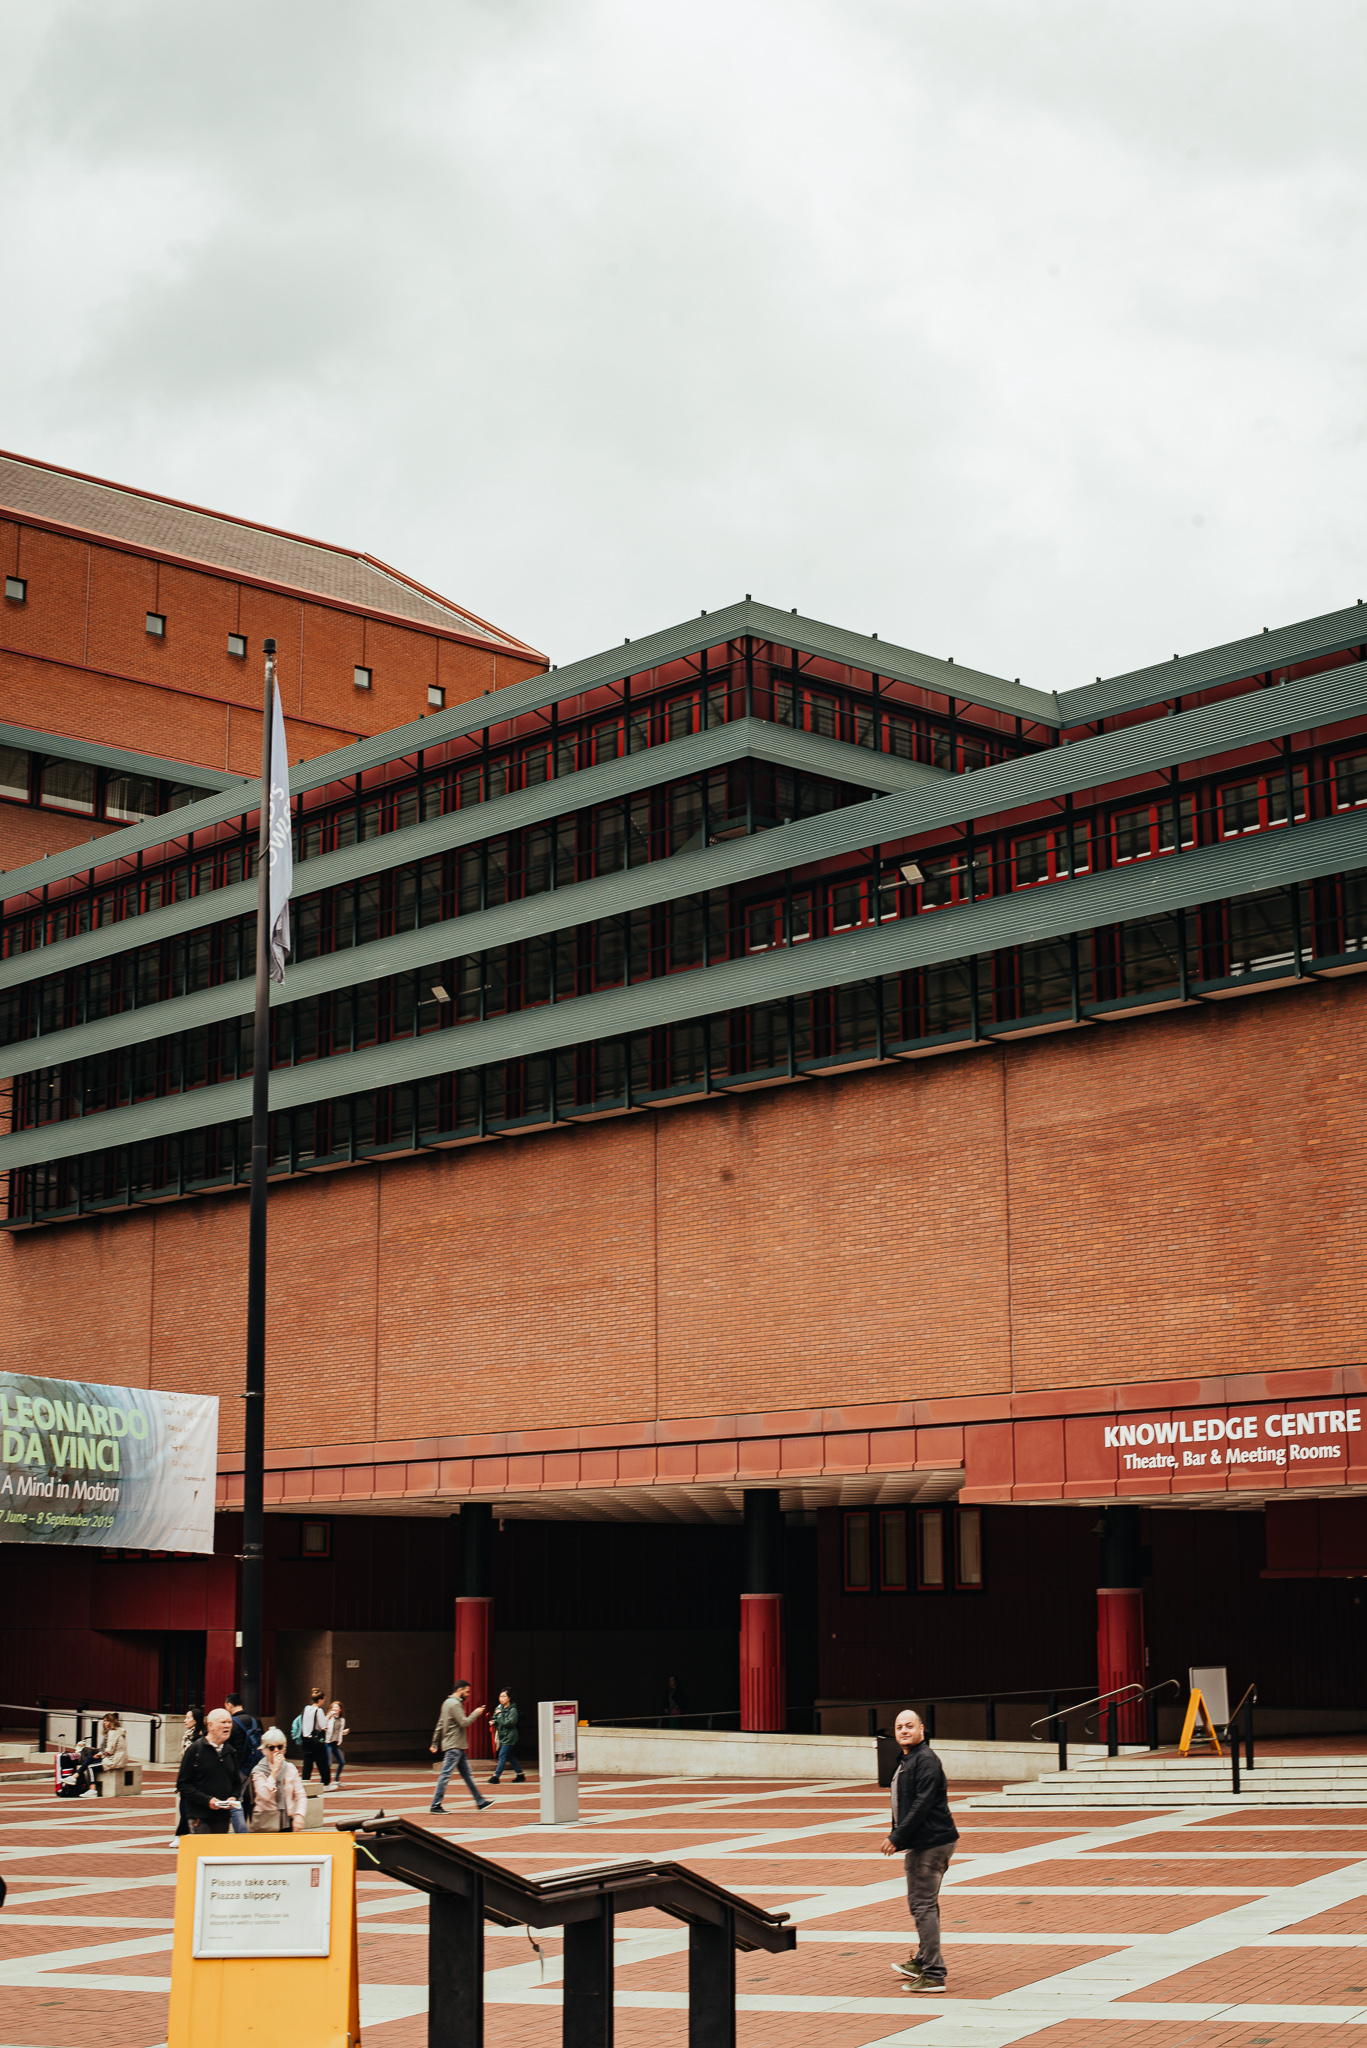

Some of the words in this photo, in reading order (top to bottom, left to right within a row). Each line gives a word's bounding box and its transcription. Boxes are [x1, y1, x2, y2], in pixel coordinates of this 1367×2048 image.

[0, 1393, 149, 1440] LEONARDO
[1104, 1416, 1258, 1448] KNOWLEDGE
[1264, 1409, 1362, 1438] CENTRE
[2, 1430, 46, 1466] DA
[49, 1434, 120, 1472] VINCI
[1123, 1453, 1179, 1470] Theatre,
[1183, 1450, 1207, 1467] Bar
[1210, 1448, 1222, 1465] &
[1226, 1446, 1286, 1466] Meeting
[1289, 1444, 1341, 1461] Rooms
[0, 1475, 14, 1495] A
[16, 1475, 55, 1498] Mind
[56, 1478, 70, 1499] in
[72, 1479, 120, 1502] Motion
[4, 1510, 28, 1524] June
[36, 1511, 45, 1525] 8
[44, 1512, 92, 1529] September
[91, 1515, 115, 1529] 2019
[211, 1878, 242, 1887] Please
[244, 1878, 265, 1887] take
[210, 1891, 241, 1901] Piazza
[243, 1891, 282, 1901] slippery
